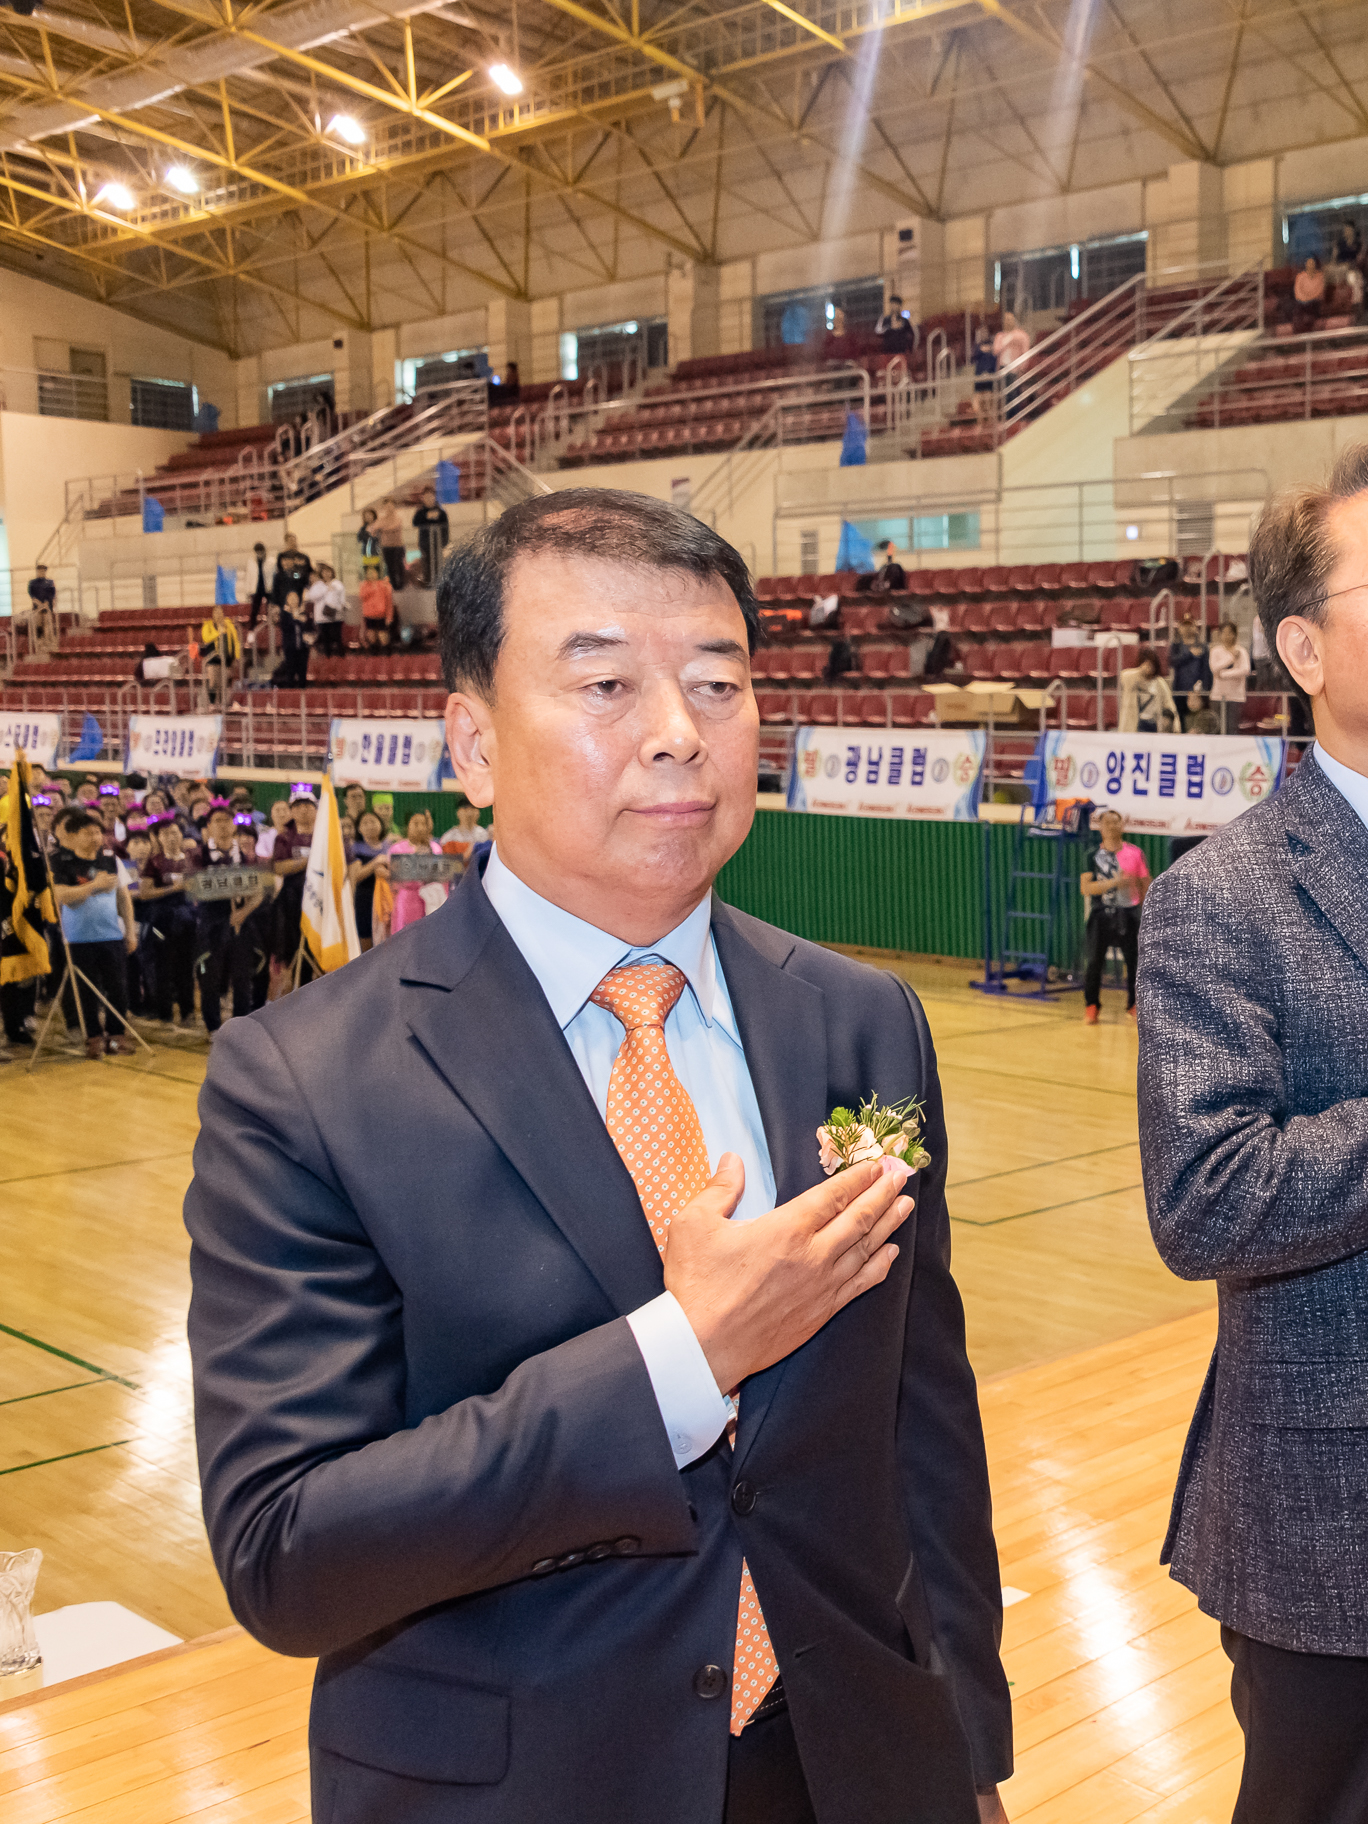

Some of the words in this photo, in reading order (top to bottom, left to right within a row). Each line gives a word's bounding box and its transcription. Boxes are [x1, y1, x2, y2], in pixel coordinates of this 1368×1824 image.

[845, 746, 927, 786] 광남클럽
[1053, 755, 1071, 788] 필
[1106, 751, 1206, 799] 양진클럽
[1246, 765, 1268, 797] 승
